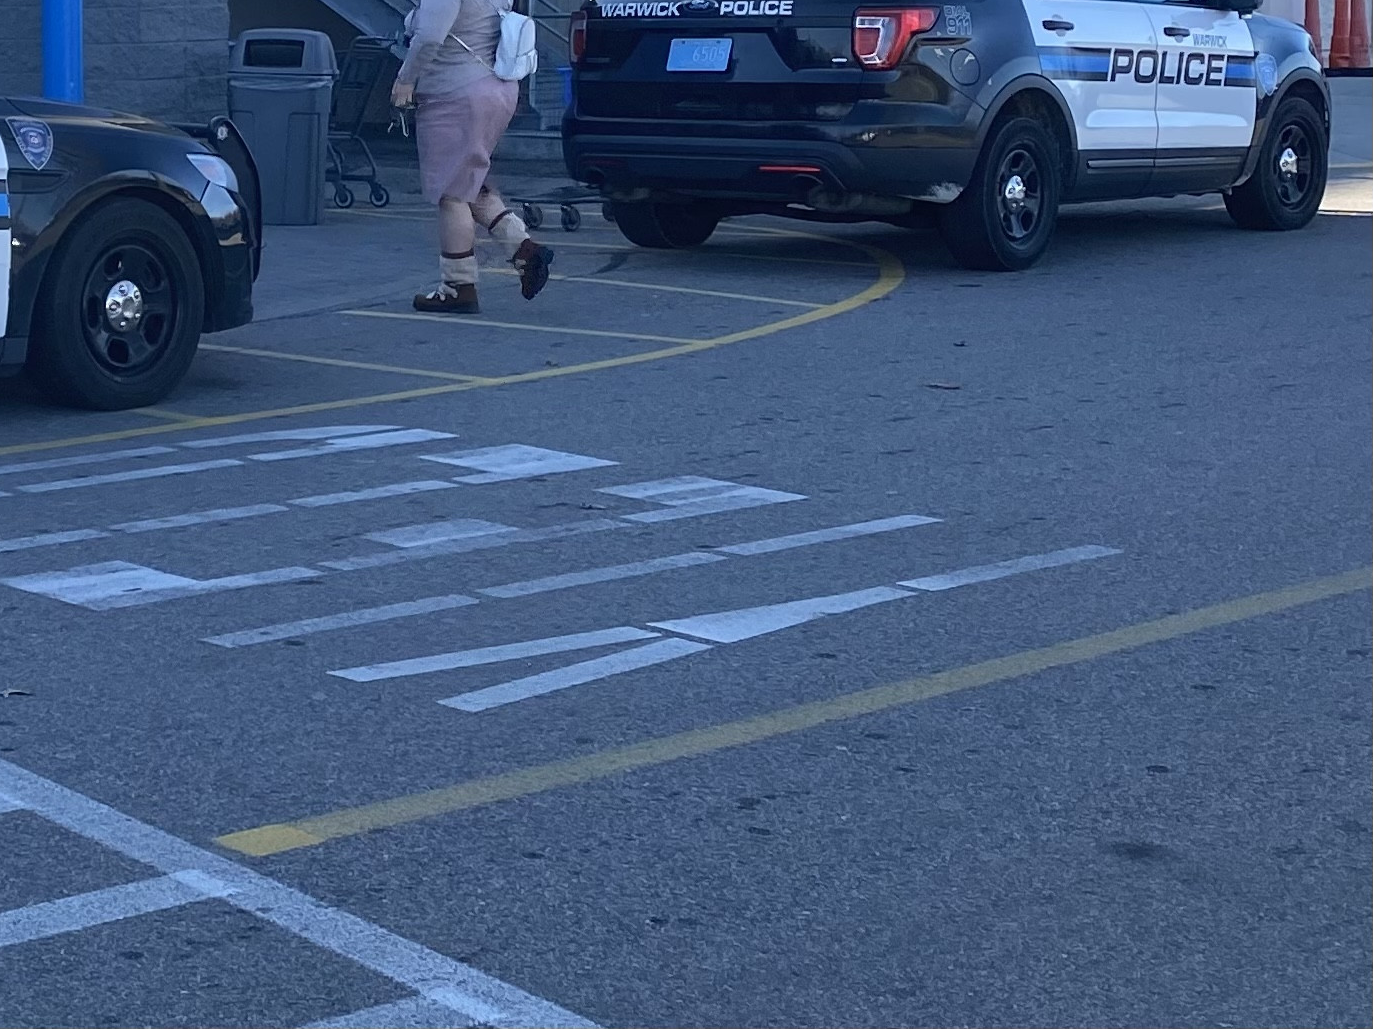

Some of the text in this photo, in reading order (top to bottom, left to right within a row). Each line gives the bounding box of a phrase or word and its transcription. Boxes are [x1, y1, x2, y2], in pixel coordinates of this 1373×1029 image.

[601, 0, 794, 17] WARWICK POLICE
[946, 14, 972, 36] 911
[1192, 33, 1227, 48] WARWICK
[692, 46, 727, 63] 6505
[1110, 48, 1225, 86] POLICE
